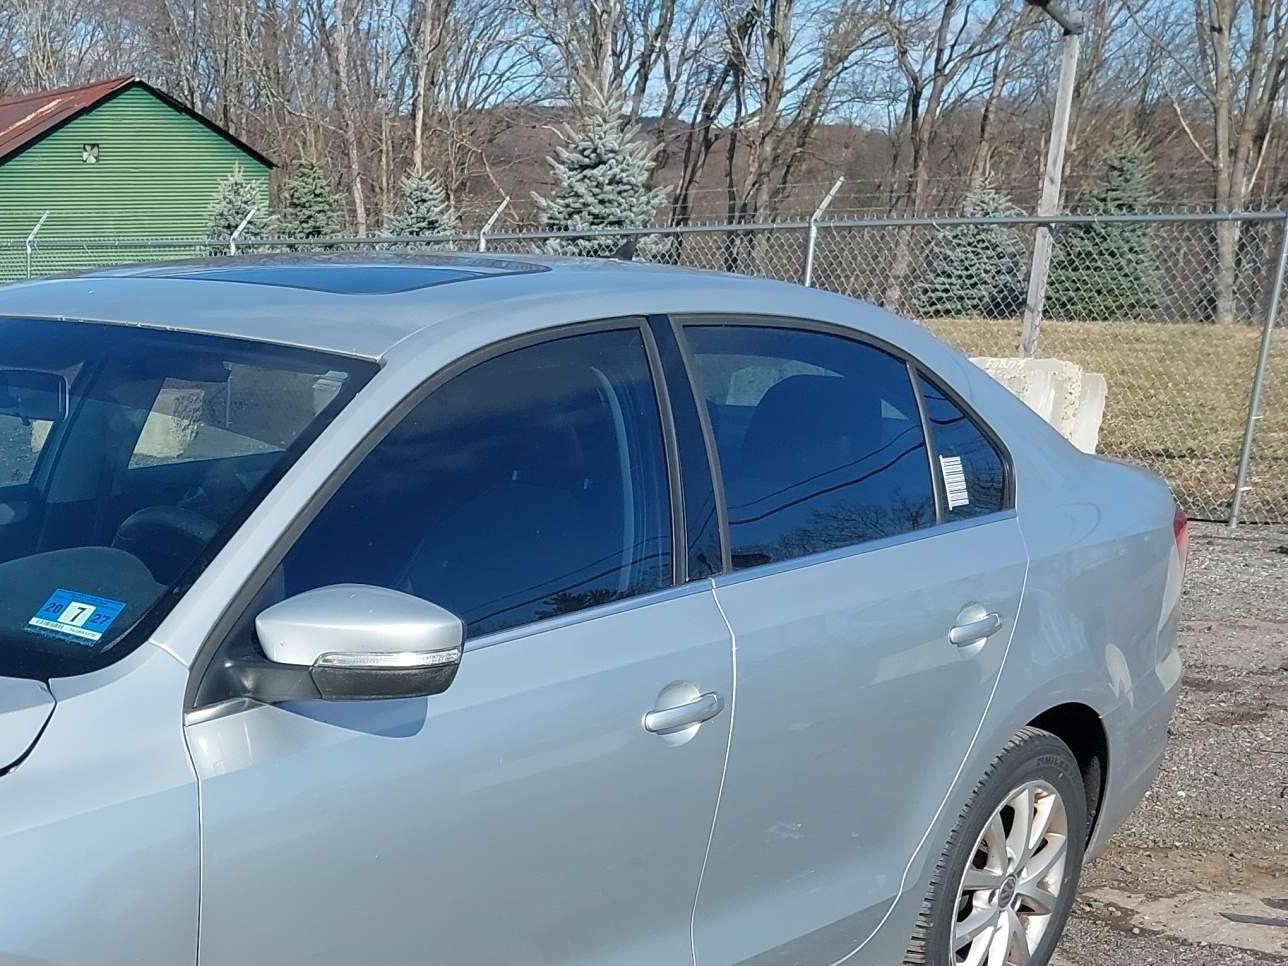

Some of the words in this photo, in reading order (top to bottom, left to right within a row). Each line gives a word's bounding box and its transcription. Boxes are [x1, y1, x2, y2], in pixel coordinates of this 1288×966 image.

[44, 602, 64, 614] 20
[70, 606, 88, 623] 7
[90, 613, 111, 625] 27
